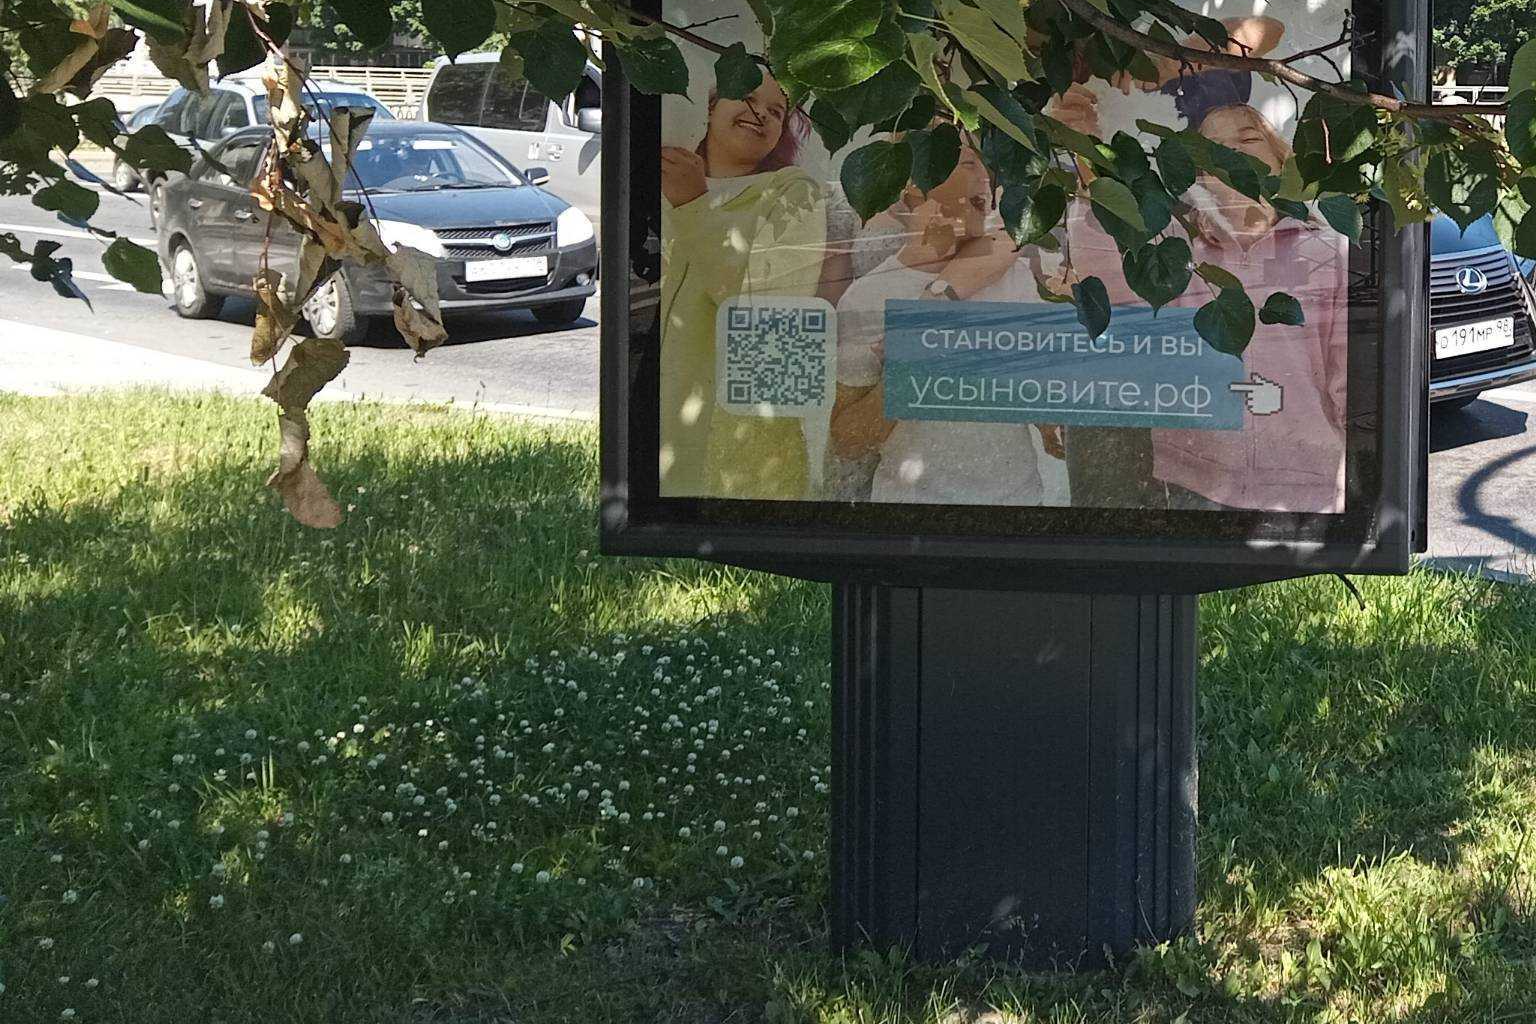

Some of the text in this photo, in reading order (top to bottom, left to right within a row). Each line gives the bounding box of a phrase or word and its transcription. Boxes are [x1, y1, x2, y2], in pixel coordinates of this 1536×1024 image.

[920, 328, 1203, 357] СТАНОВИТЕСЬ И ВЫ
[909, 374, 1212, 415] усыновите.рф
